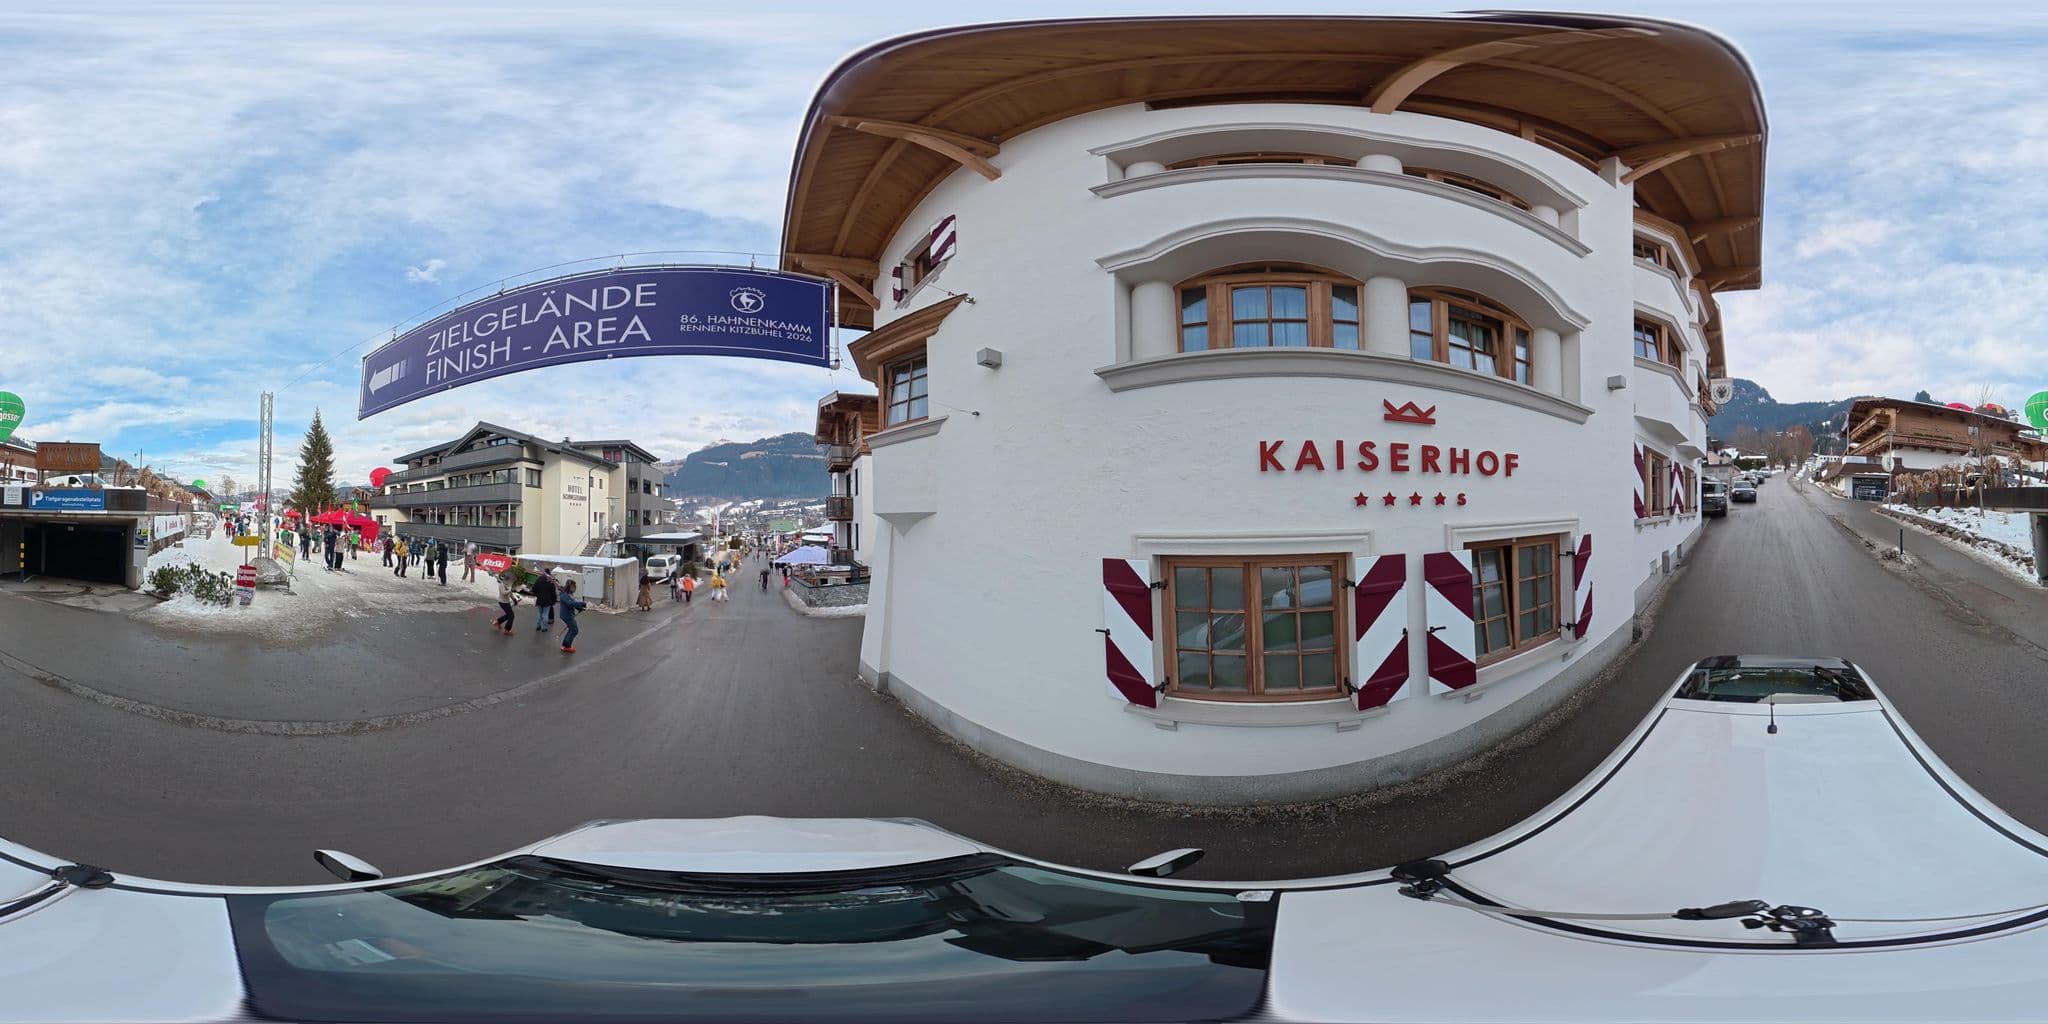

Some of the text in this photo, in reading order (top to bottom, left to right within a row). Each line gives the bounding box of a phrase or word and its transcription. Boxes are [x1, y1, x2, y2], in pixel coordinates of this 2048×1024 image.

[426, 283, 657, 357] ZIELGELÄNDE
[680, 314, 812, 334] 86. HAHNENKAMM
[680, 324, 813, 343] RENNEN KITZBÜHEL 2026
[426, 336, 511, 385] FINISH
[542, 314, 652, 354] AREA
[1259, 440, 1519, 477] KAISERHOF
[32, 490, 44, 506] P
